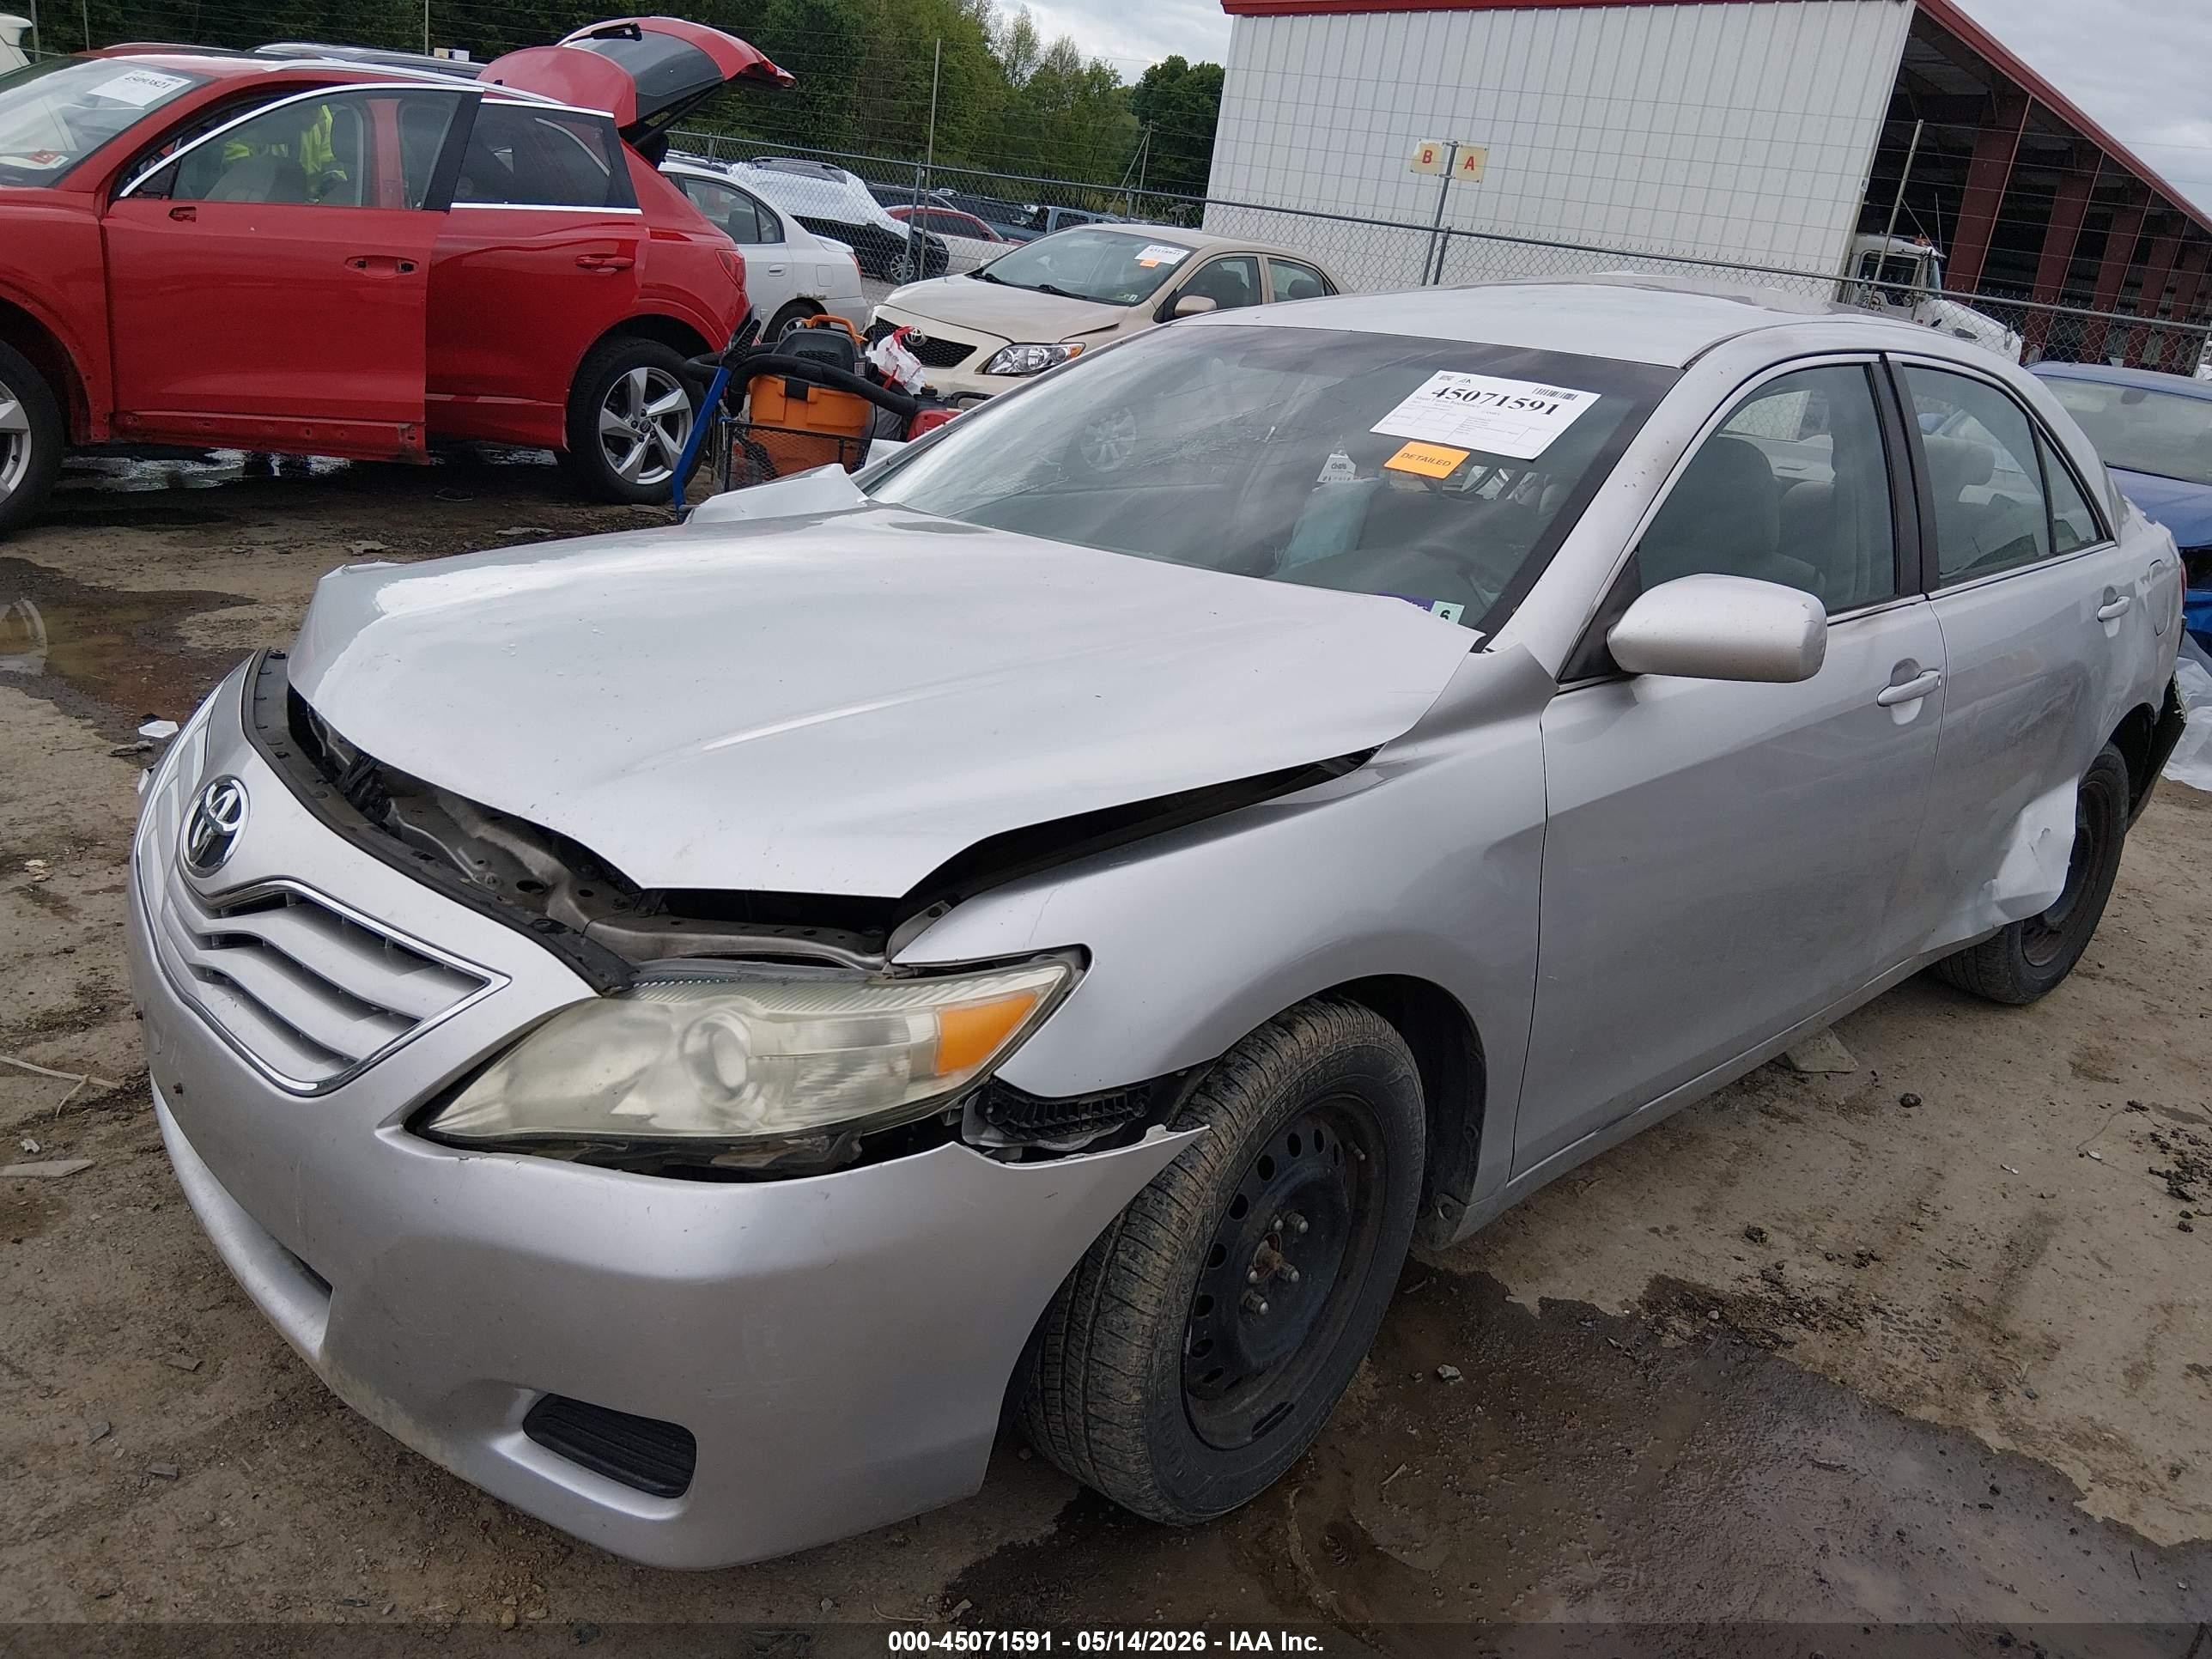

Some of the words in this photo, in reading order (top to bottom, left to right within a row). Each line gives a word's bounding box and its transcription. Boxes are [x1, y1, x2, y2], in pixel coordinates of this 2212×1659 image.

[1422, 149, 1433, 164] B
[1464, 155, 1475, 171] A
[1431, 386, 1560, 416] 45071591
[1401, 453, 1451, 467] DETAILED
